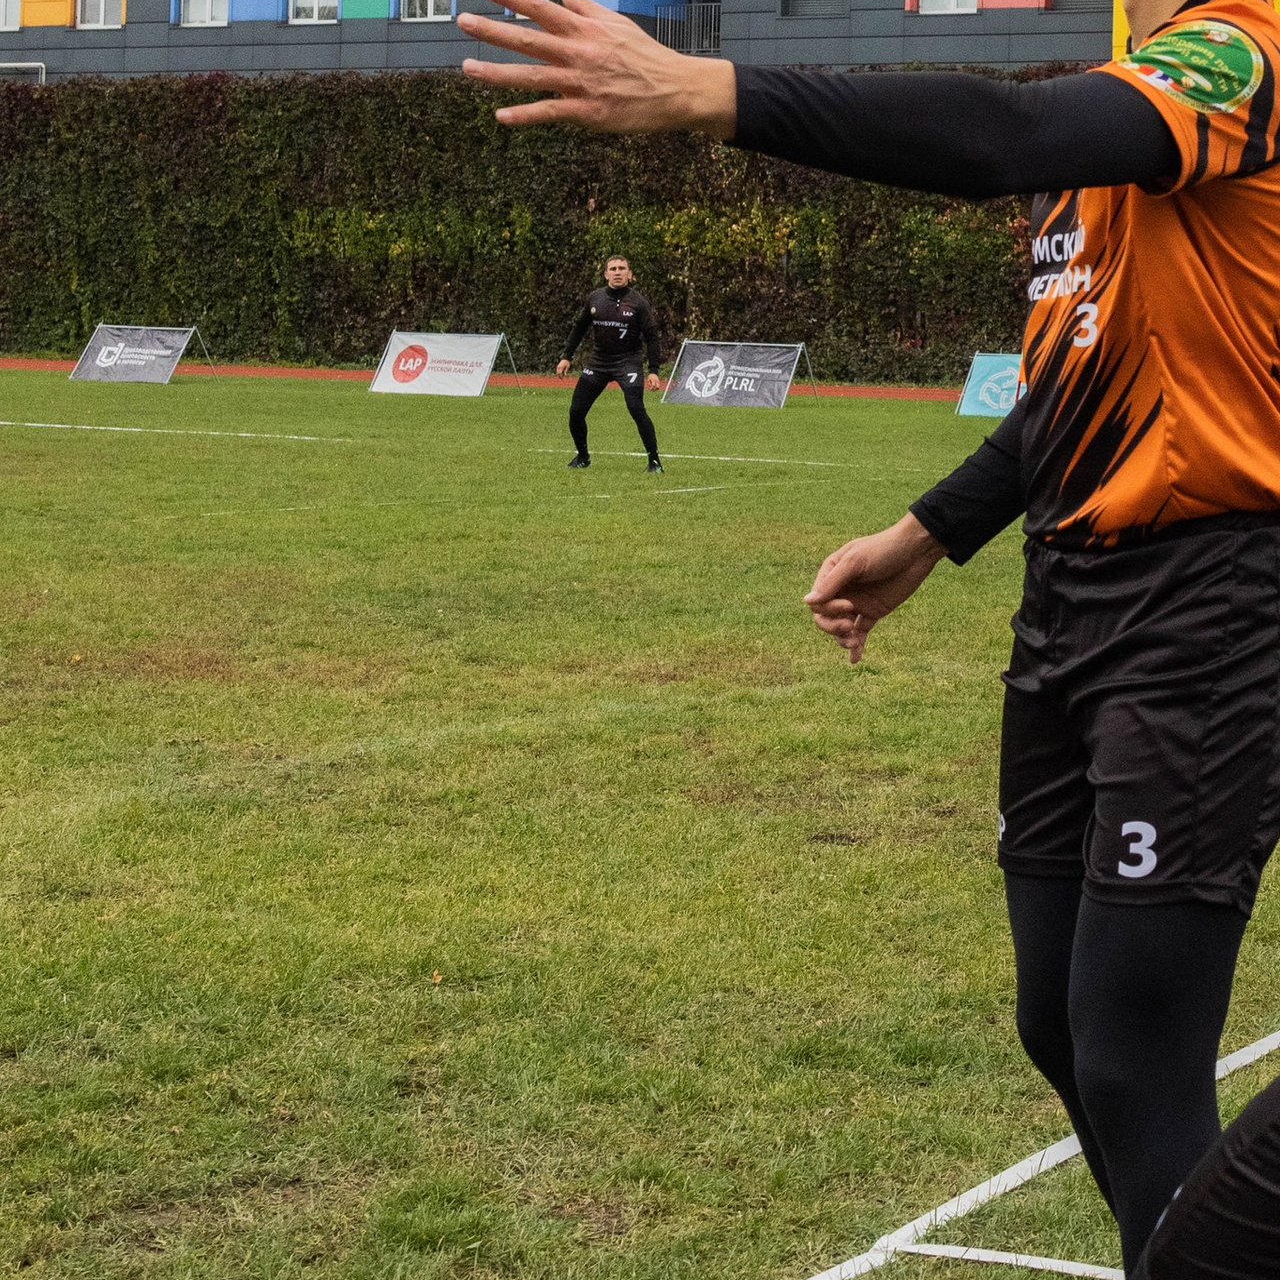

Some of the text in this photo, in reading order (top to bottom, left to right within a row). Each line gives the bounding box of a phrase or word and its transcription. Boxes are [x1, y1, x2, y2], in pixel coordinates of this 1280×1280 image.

[1032, 217, 1086, 264] МСКИЙ
[618, 327, 628, 339] 7
[1073, 302, 1098, 348] 3
[398, 358, 422, 370] LAP
[627, 372, 638, 383] 7
[724, 376, 755, 392] PLRL
[1118, 820, 1158, 878] 3
